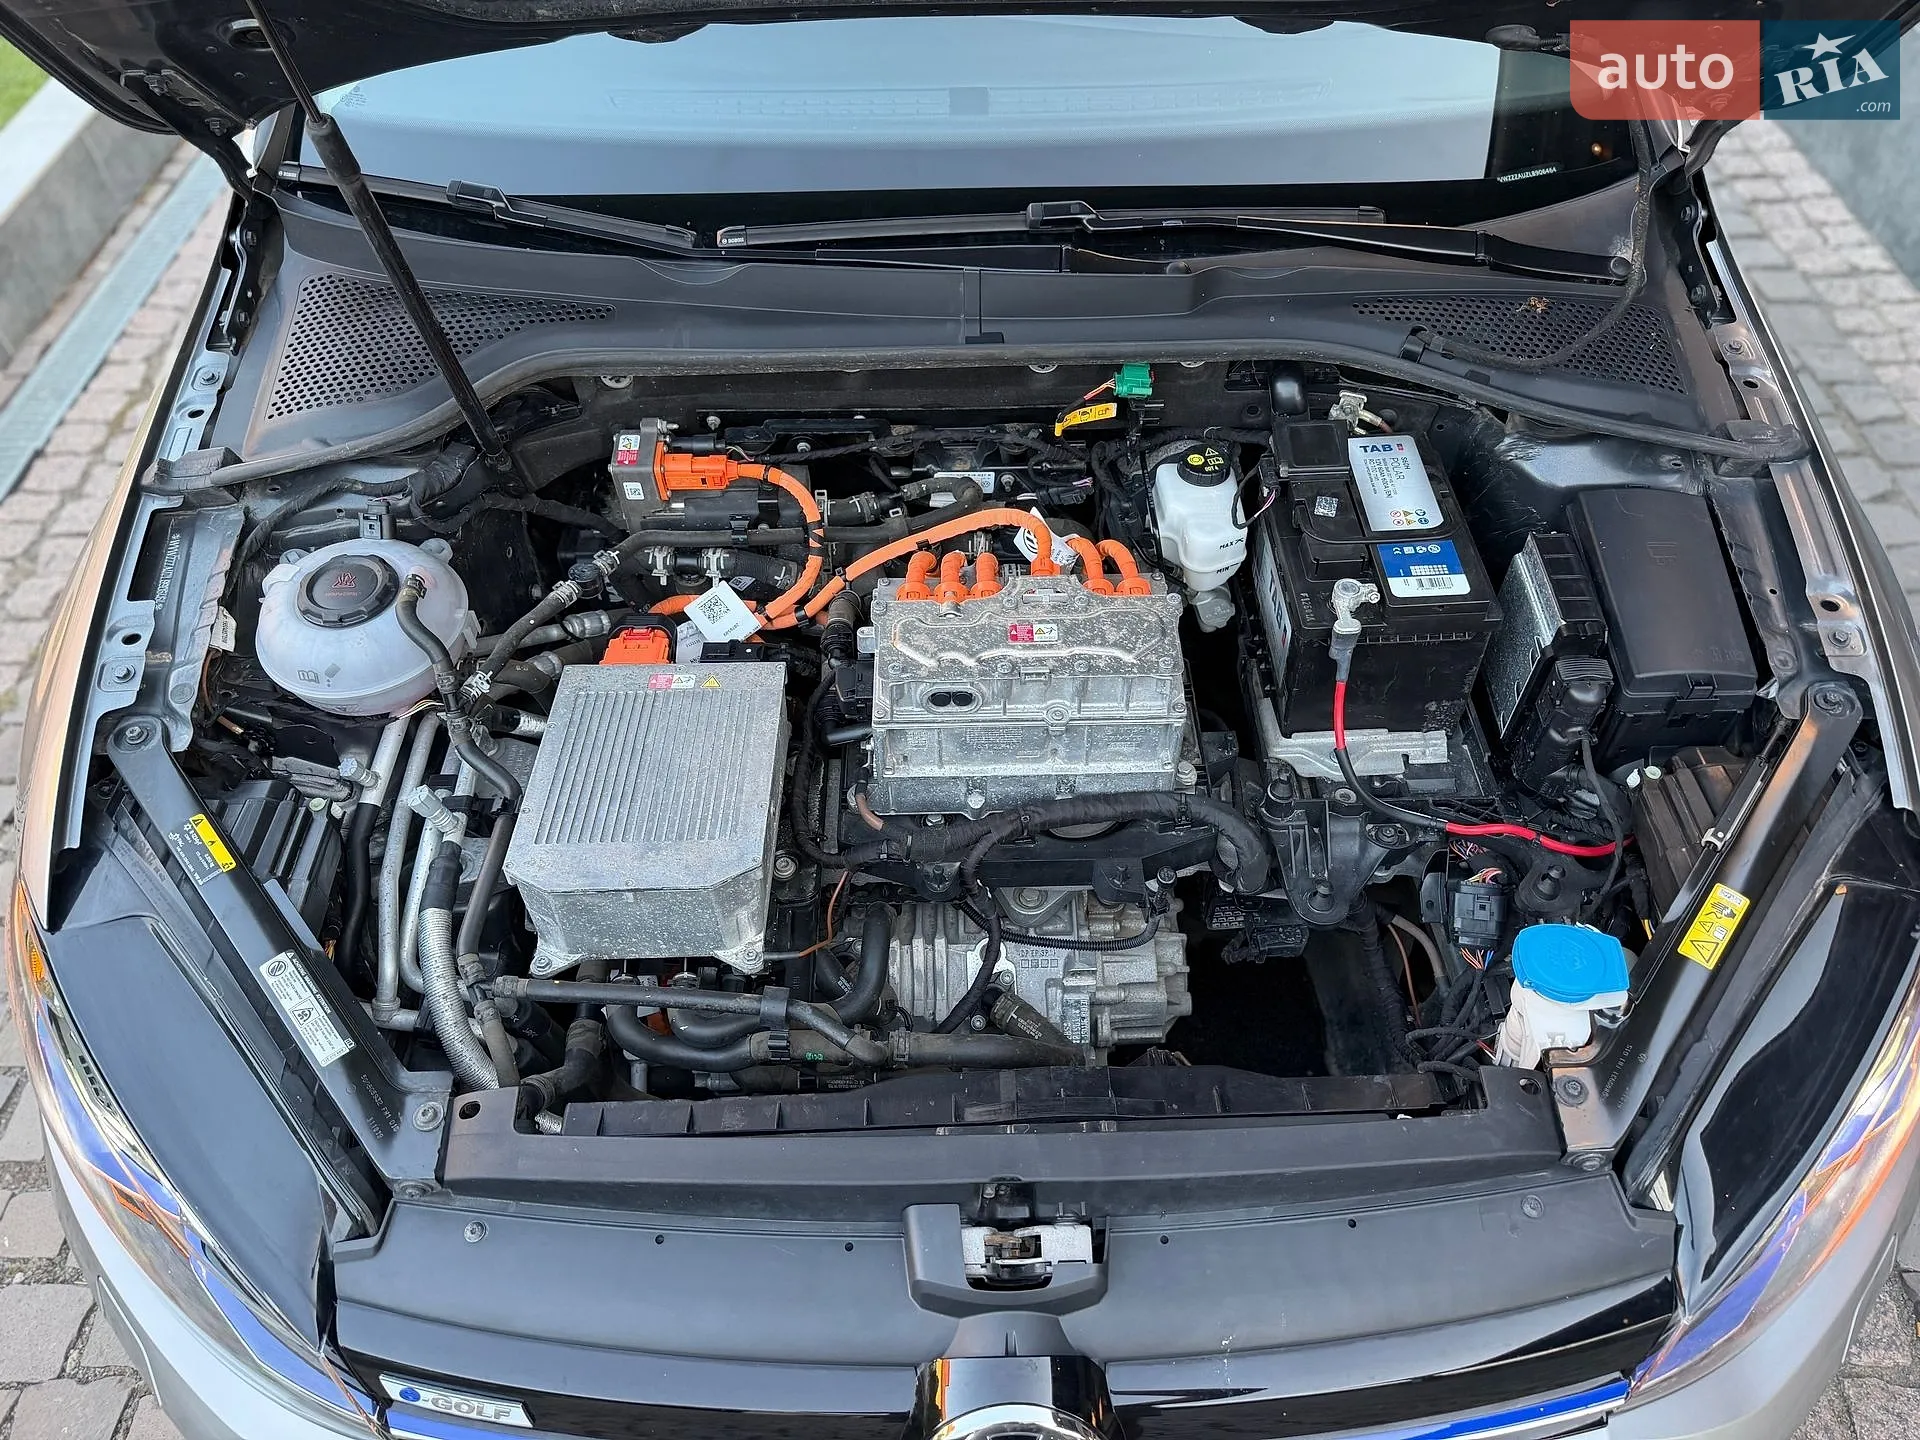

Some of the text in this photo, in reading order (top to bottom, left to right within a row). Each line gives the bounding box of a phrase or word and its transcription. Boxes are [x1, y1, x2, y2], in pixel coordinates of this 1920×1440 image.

[1359, 444, 1393, 453] TAB
[1389, 457, 1405, 480] POLAR
[1219, 541, 1234, 549] MAX
[1216, 566, 1230, 574] MIN
[1269, 569, 1283, 630] TAB
